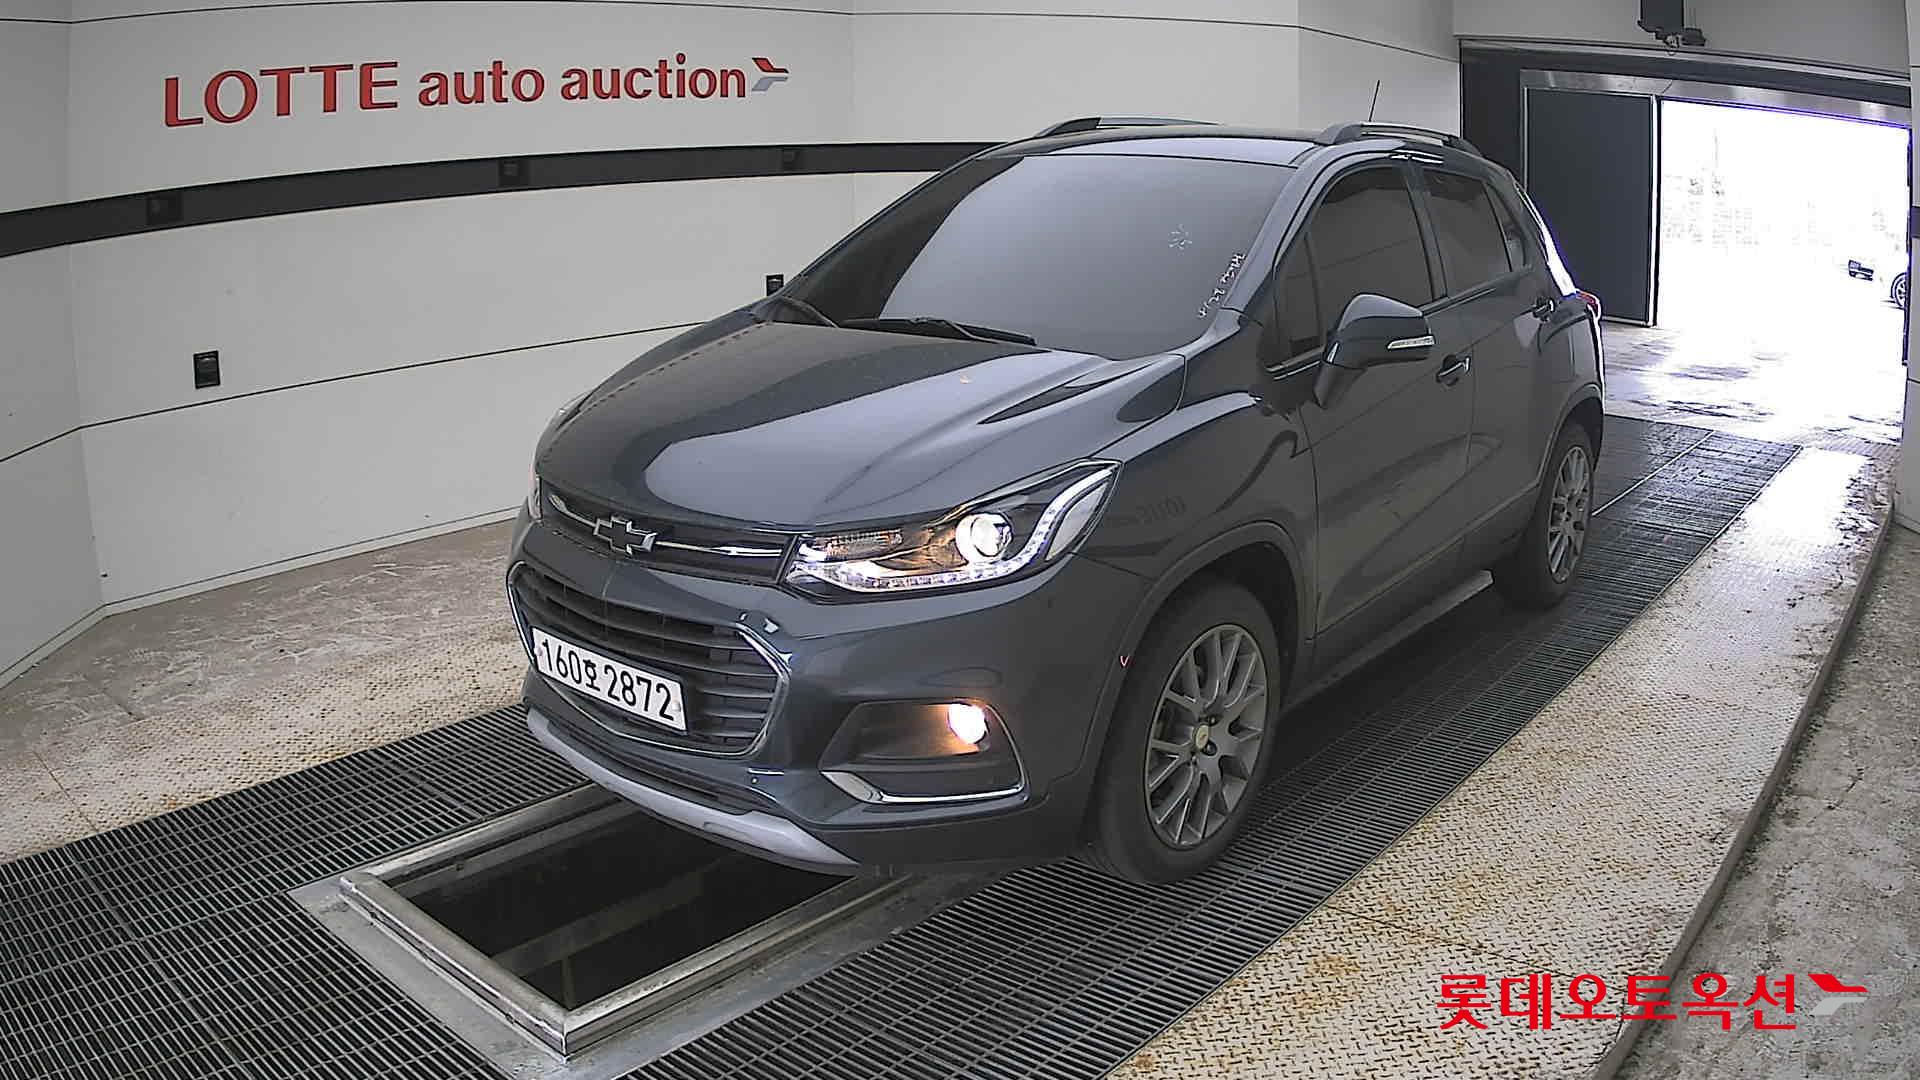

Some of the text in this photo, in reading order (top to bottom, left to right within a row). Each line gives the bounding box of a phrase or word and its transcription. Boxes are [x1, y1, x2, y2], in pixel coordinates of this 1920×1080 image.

[164, 53, 746, 127] LOTTE auto auction
